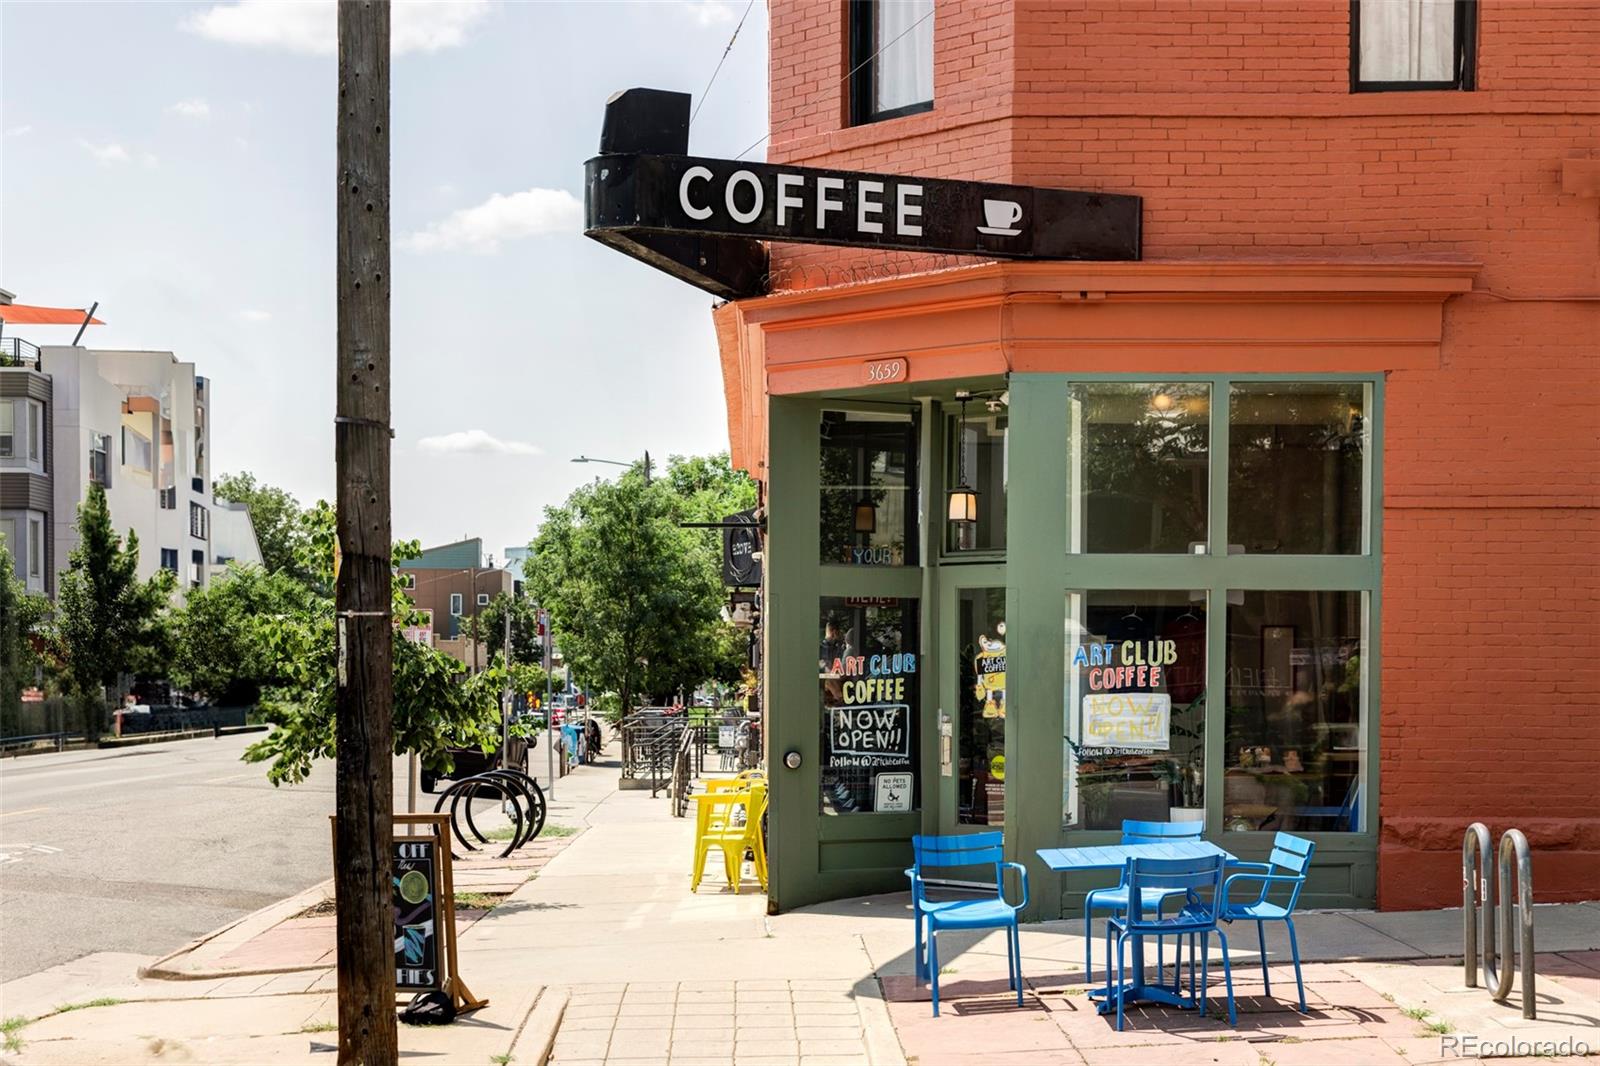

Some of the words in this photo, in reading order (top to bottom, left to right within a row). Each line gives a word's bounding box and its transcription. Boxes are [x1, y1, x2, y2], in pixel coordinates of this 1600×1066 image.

[679, 166, 923, 237] COFFEE
[867, 361, 900, 381] 3659
[853, 548, 892, 565] YOUR
[830, 655, 865, 677] ART
[869, 652, 916, 676] CLUB
[1072, 643, 1114, 667] ART
[1121, 639, 1178, 667] CLUB
[1089, 665, 1161, 691] COFFEE
[842, 677, 905, 704] COFFEE
[1091, 694, 1153, 717] NOW
[839, 709, 897, 730] NOW
[838, 728, 902, 751] OPEN!!
[399, 843, 430, 858] OFF
[396, 968, 434, 986] HIES
